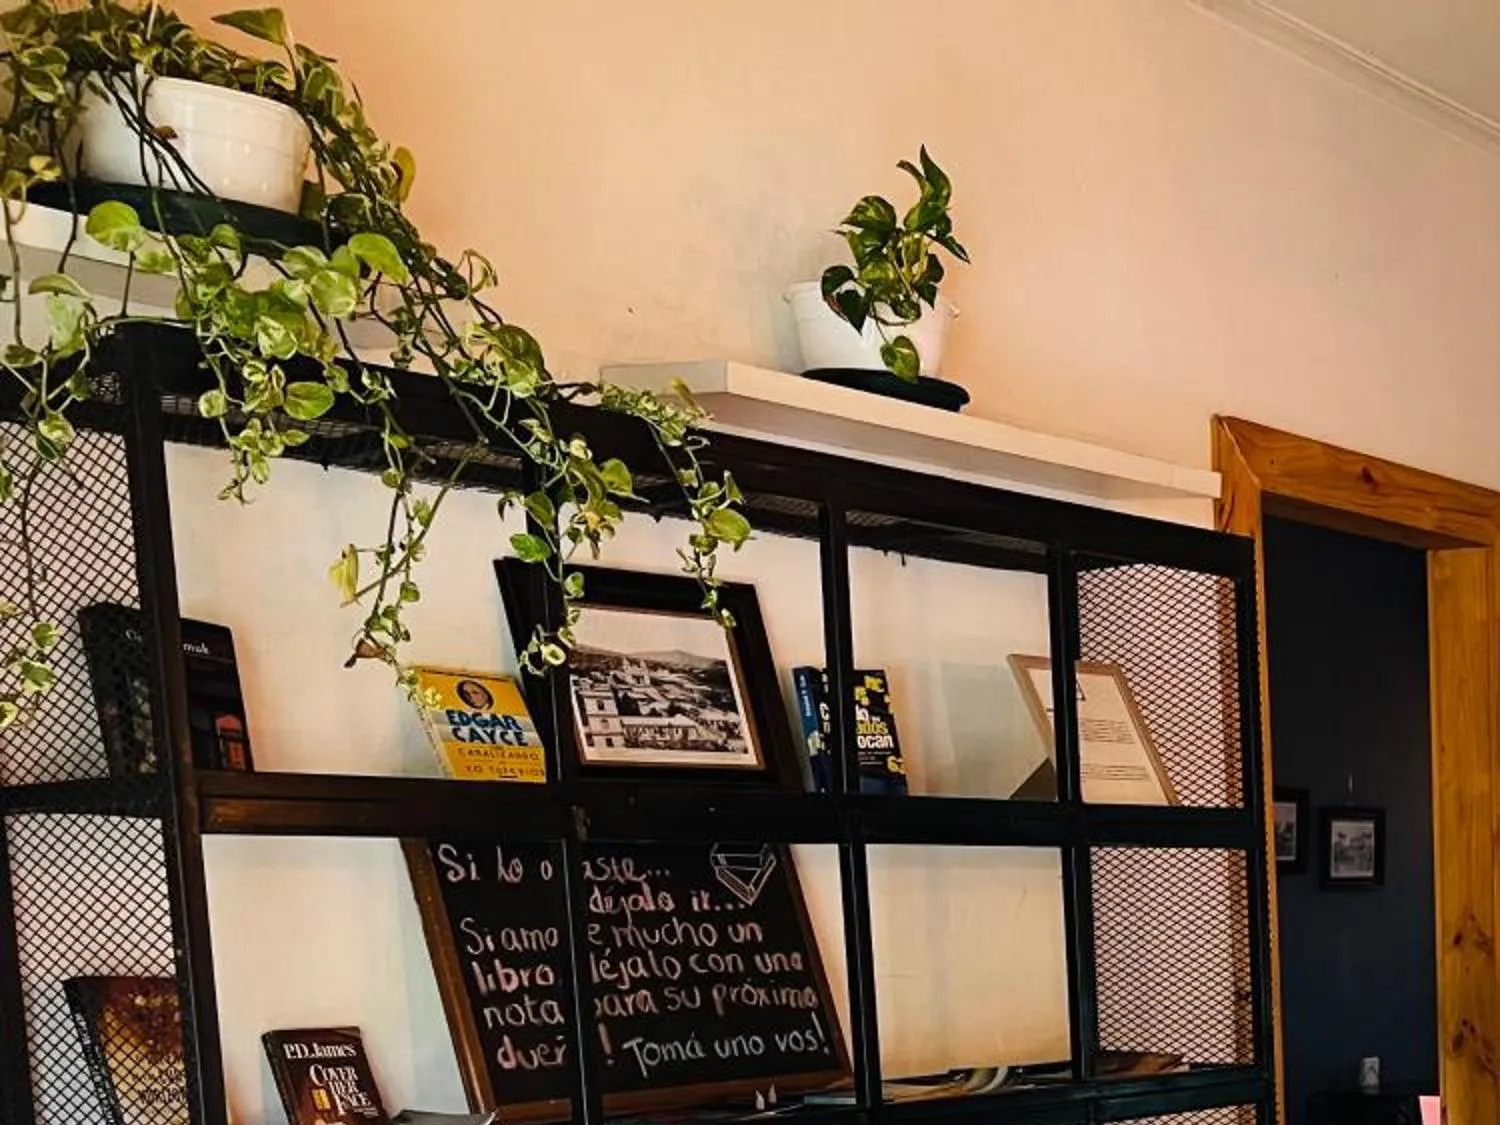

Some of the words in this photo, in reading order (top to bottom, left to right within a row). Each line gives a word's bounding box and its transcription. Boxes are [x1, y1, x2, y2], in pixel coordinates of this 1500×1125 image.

[445, 709, 523, 731] EDGAR
[451, 727, 529, 747] CAYCE
[437, 843, 480, 883] Si
[496, 845, 523, 883] lo
[460, 916, 495, 955] Si
[610, 916, 719, 949] mucho
[727, 922, 763, 943] un
[471, 958, 555, 996] libro
[688, 952, 744, 974] con
[482, 994, 566, 1030] nota
[621, 1030, 706, 1078] Tomá
[713, 1035, 765, 1060] uno
[774, 1010, 830, 1055] vos!
[308, 1063, 359, 1087] COVER
